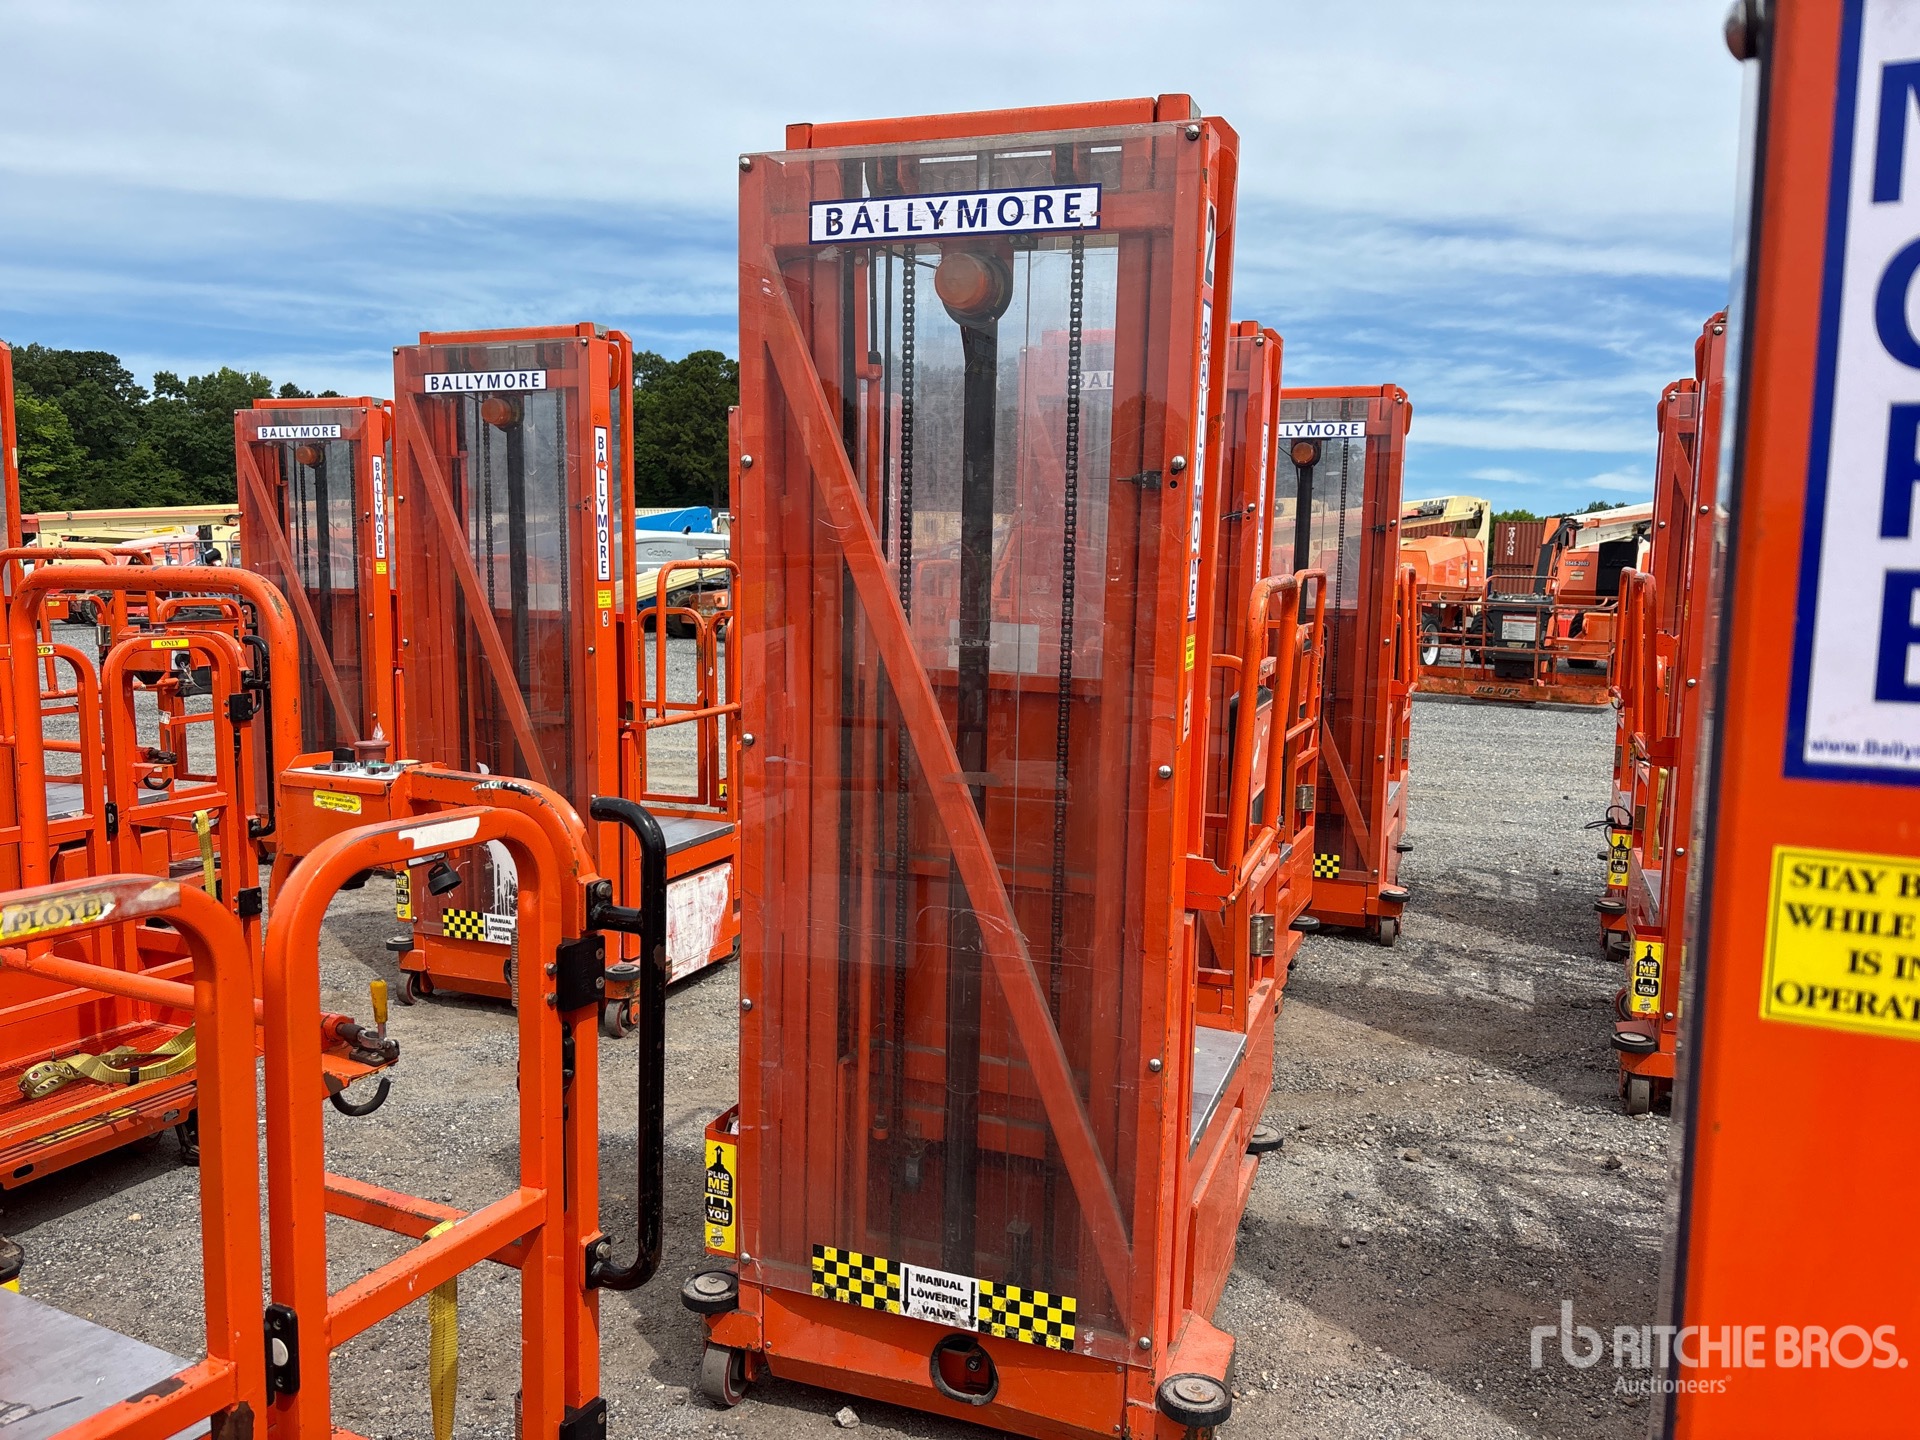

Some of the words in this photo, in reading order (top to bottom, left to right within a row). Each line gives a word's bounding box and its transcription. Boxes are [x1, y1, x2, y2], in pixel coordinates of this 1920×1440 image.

[825, 192, 1082, 236] BALLYMORE
[1205, 205, 1215, 287] 2
[431, 372, 540, 391] BALLYMORE
[261, 426, 337, 438] BALLYMORE
[1278, 424, 1359, 437] LYMORE
[374, 462, 384, 554] BALLYMORE
[597, 436, 608, 574] BALLYMORE
[646, 548, 673, 557] Genie
[603, 611, 608, 626] 3
[161, 639, 180, 647] ONLY
[1474, 685, 1496, 695] JLG
[1497, 687, 1521, 697] LIFT
[1790, 863, 1886, 894] STAY
[0, 898, 106, 933] PLOYE
[490, 917, 512, 925] MANUAL
[1784, 902, 1917, 940] WHILE
[488, 925, 512, 933] LOWERIN
[493, 934, 510, 942] VALVE
[1639, 965, 1657, 975] ME
[1847, 949, 1882, 976] IS
[708, 1170, 730, 1181] PLUG
[707, 1177, 730, 1192] ME
[708, 1208, 729, 1221] YOU
[916, 1273, 964, 1292] MANUAL
[910, 1287, 968, 1308] LOWERING
[922, 1305, 956, 1321] VALVE
